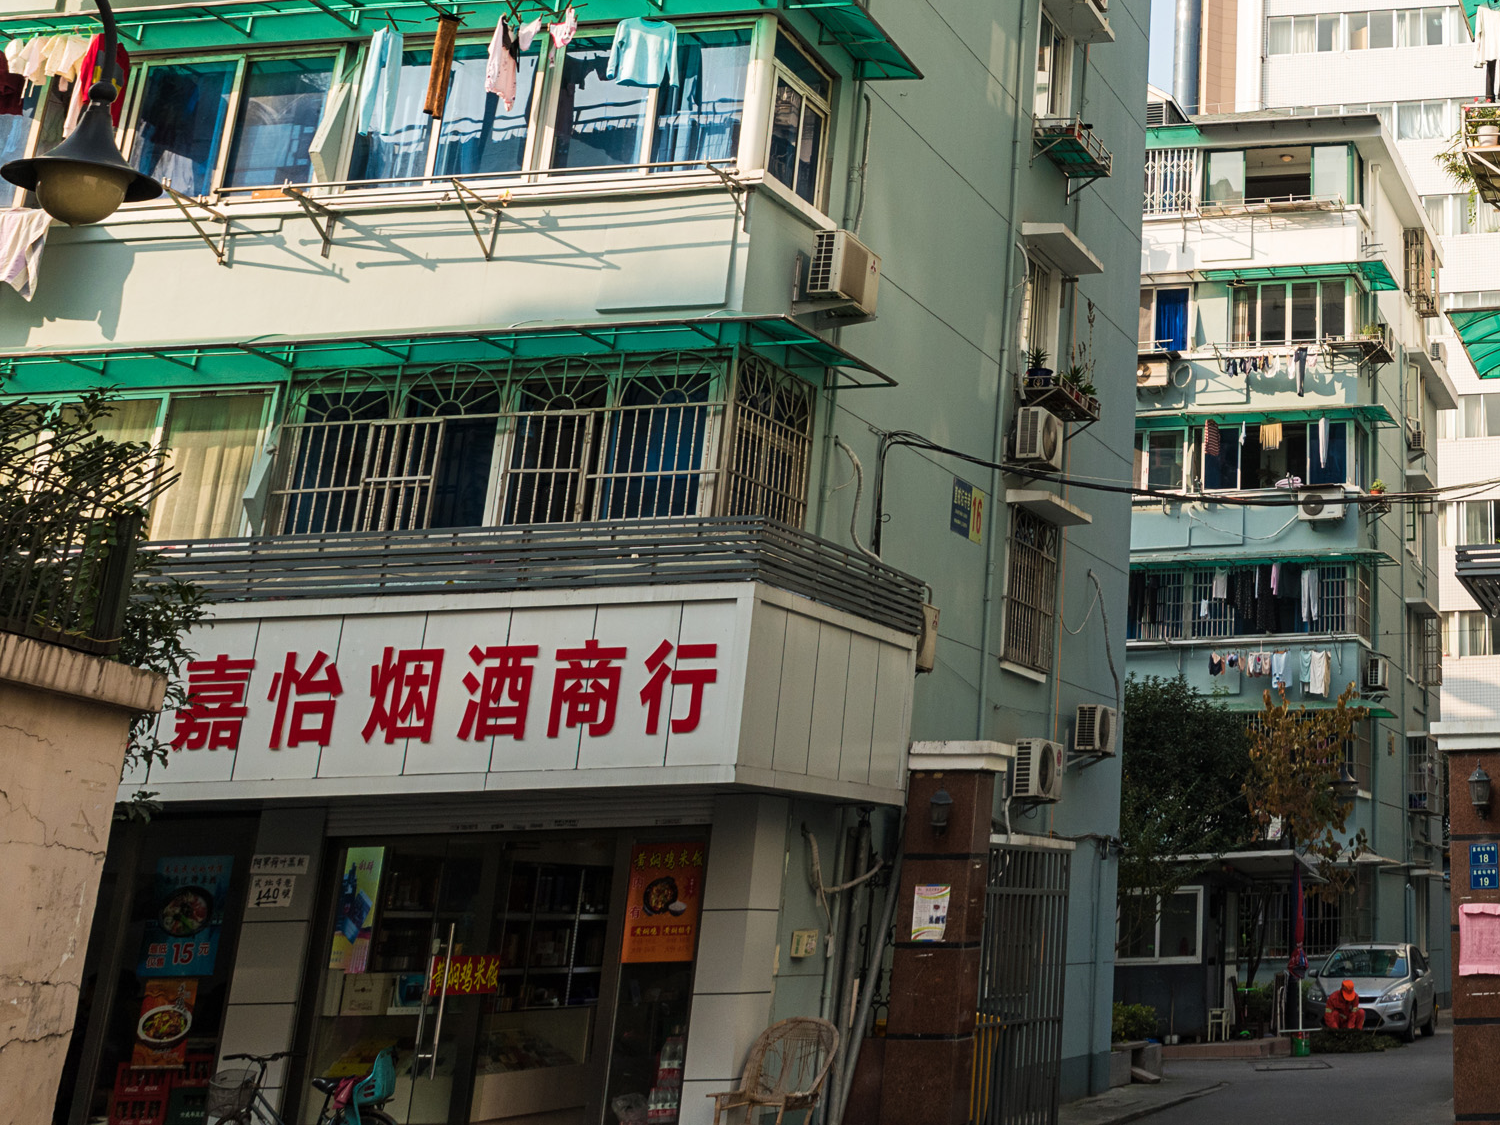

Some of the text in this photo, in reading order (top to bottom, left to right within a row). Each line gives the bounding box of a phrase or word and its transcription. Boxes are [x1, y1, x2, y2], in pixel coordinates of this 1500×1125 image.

[972, 497, 983, 534] 16
[170, 639, 718, 752] 嘉怡烟酒商行
[633, 849, 704, 871] 黄焖鸡米饭
[1479, 853, 1489, 863] 18
[1479, 877, 1490, 886] 19
[148, 943, 168, 955] 最低
[172, 942, 210, 965] 15 元
[431, 957, 500, 994] 黄焖鸡米饭
